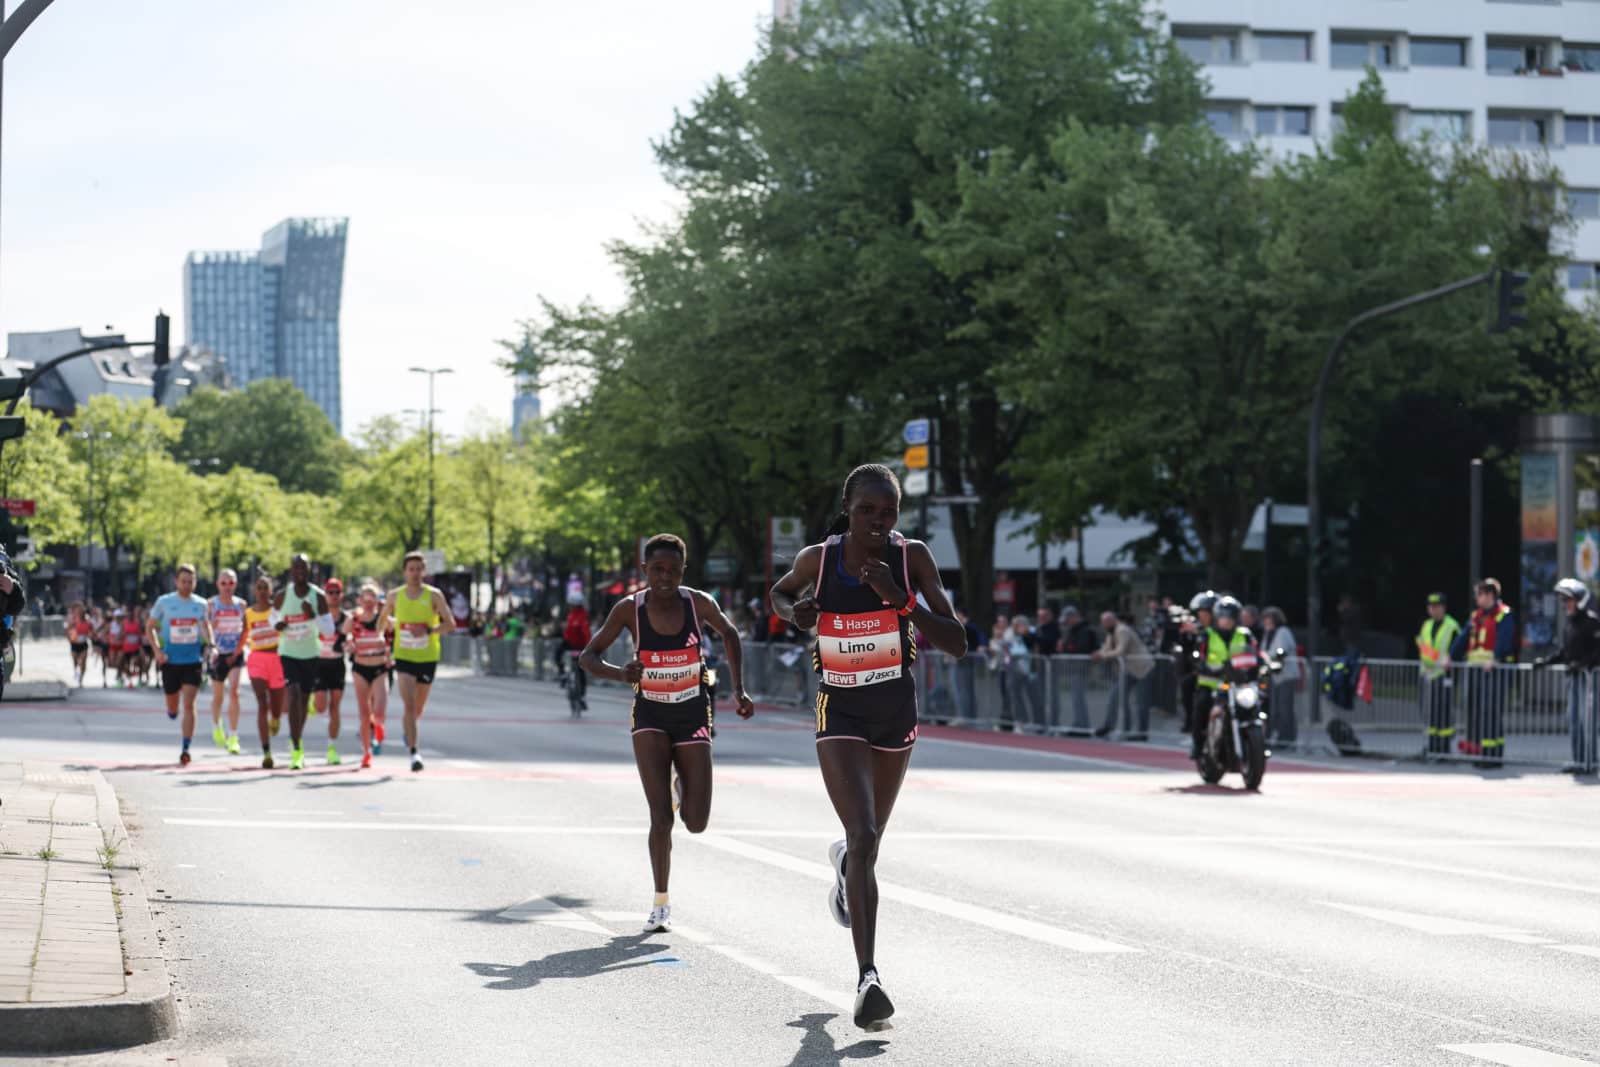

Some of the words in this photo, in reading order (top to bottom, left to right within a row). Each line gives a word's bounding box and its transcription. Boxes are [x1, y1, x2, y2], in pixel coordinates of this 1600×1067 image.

[846, 619, 881, 630] Haspa
[838, 641, 876, 654] Limo
[662, 654, 688, 663] Haspa
[646, 669, 692, 681] Wangari
[829, 673, 855, 684] REWE
